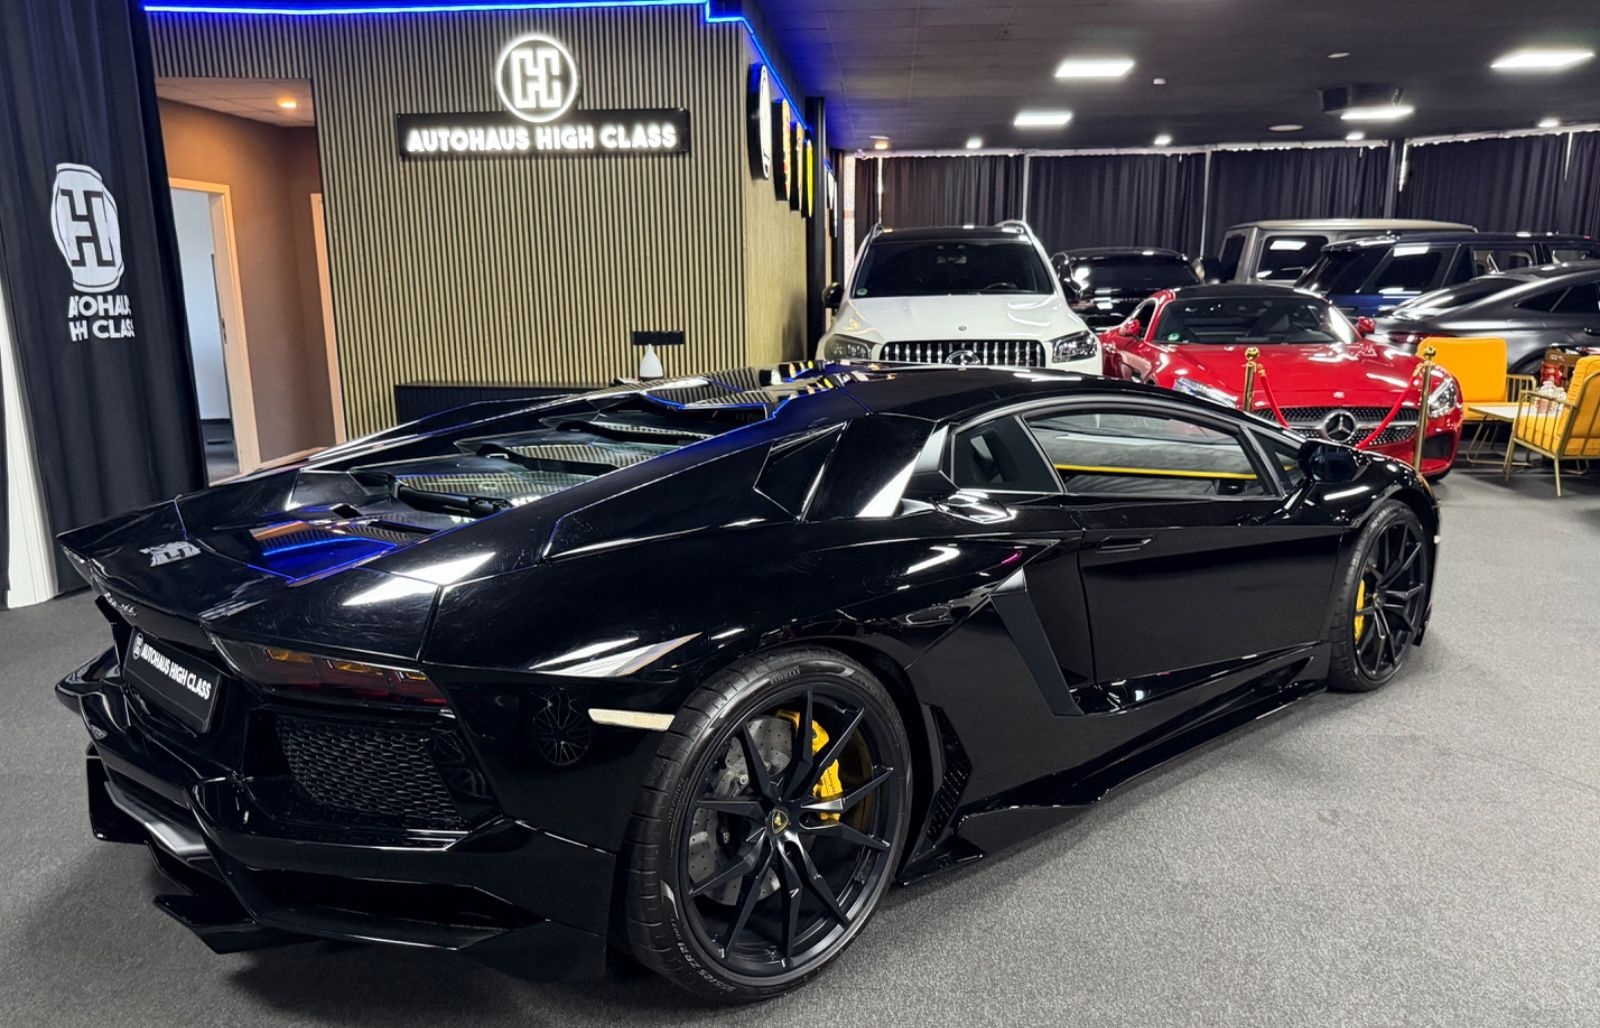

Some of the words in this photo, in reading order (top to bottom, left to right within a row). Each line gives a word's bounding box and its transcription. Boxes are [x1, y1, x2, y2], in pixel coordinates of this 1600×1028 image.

[407, 127, 529, 152] AUTOHAUS
[536, 125, 594, 149] HIGH
[600, 122, 677, 148] CLASS
[141, 643, 171, 675] AUTOHAUS
[169, 661, 188, 686] HIGH
[187, 673, 211, 700] CLASS
